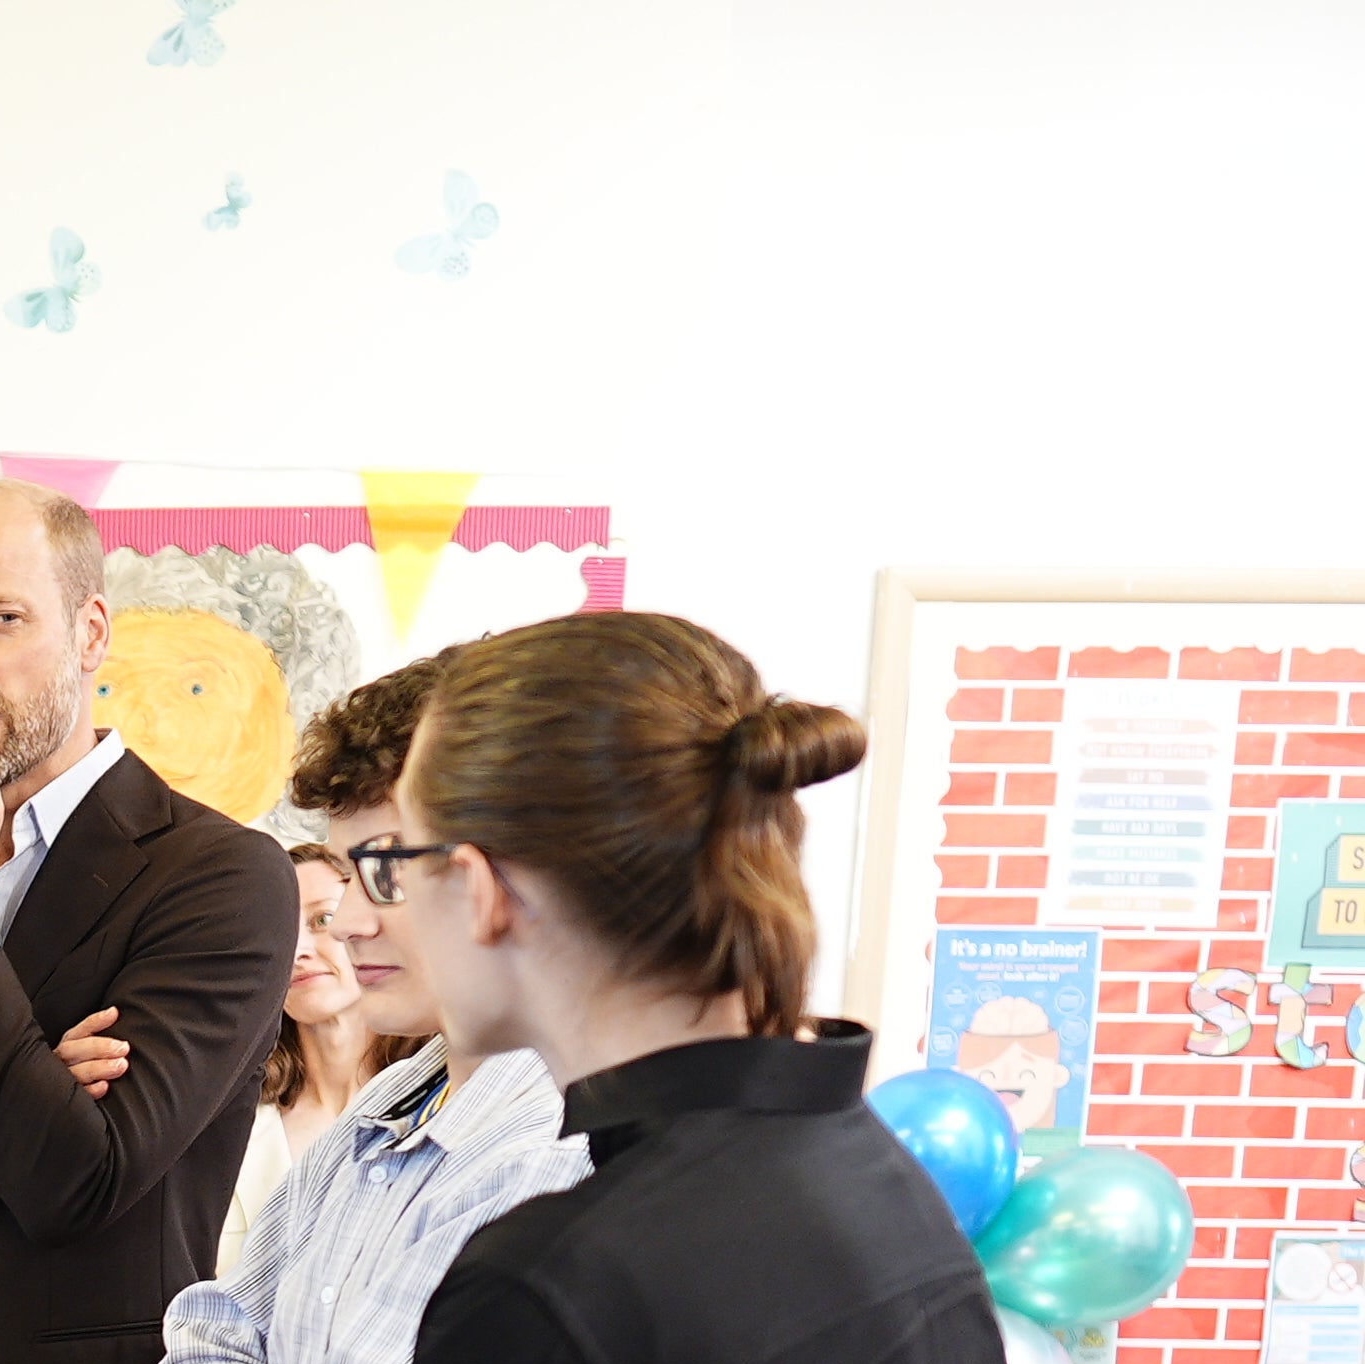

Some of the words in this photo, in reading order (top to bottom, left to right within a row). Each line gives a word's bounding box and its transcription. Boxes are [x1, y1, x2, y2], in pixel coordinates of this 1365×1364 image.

[1335, 899, 1358, 924] TO
[952, 939, 978, 957] It's
[979, 943, 992, 957] a
[994, 943, 1018, 957] no
[1022, 939, 1088, 958] brainer!
